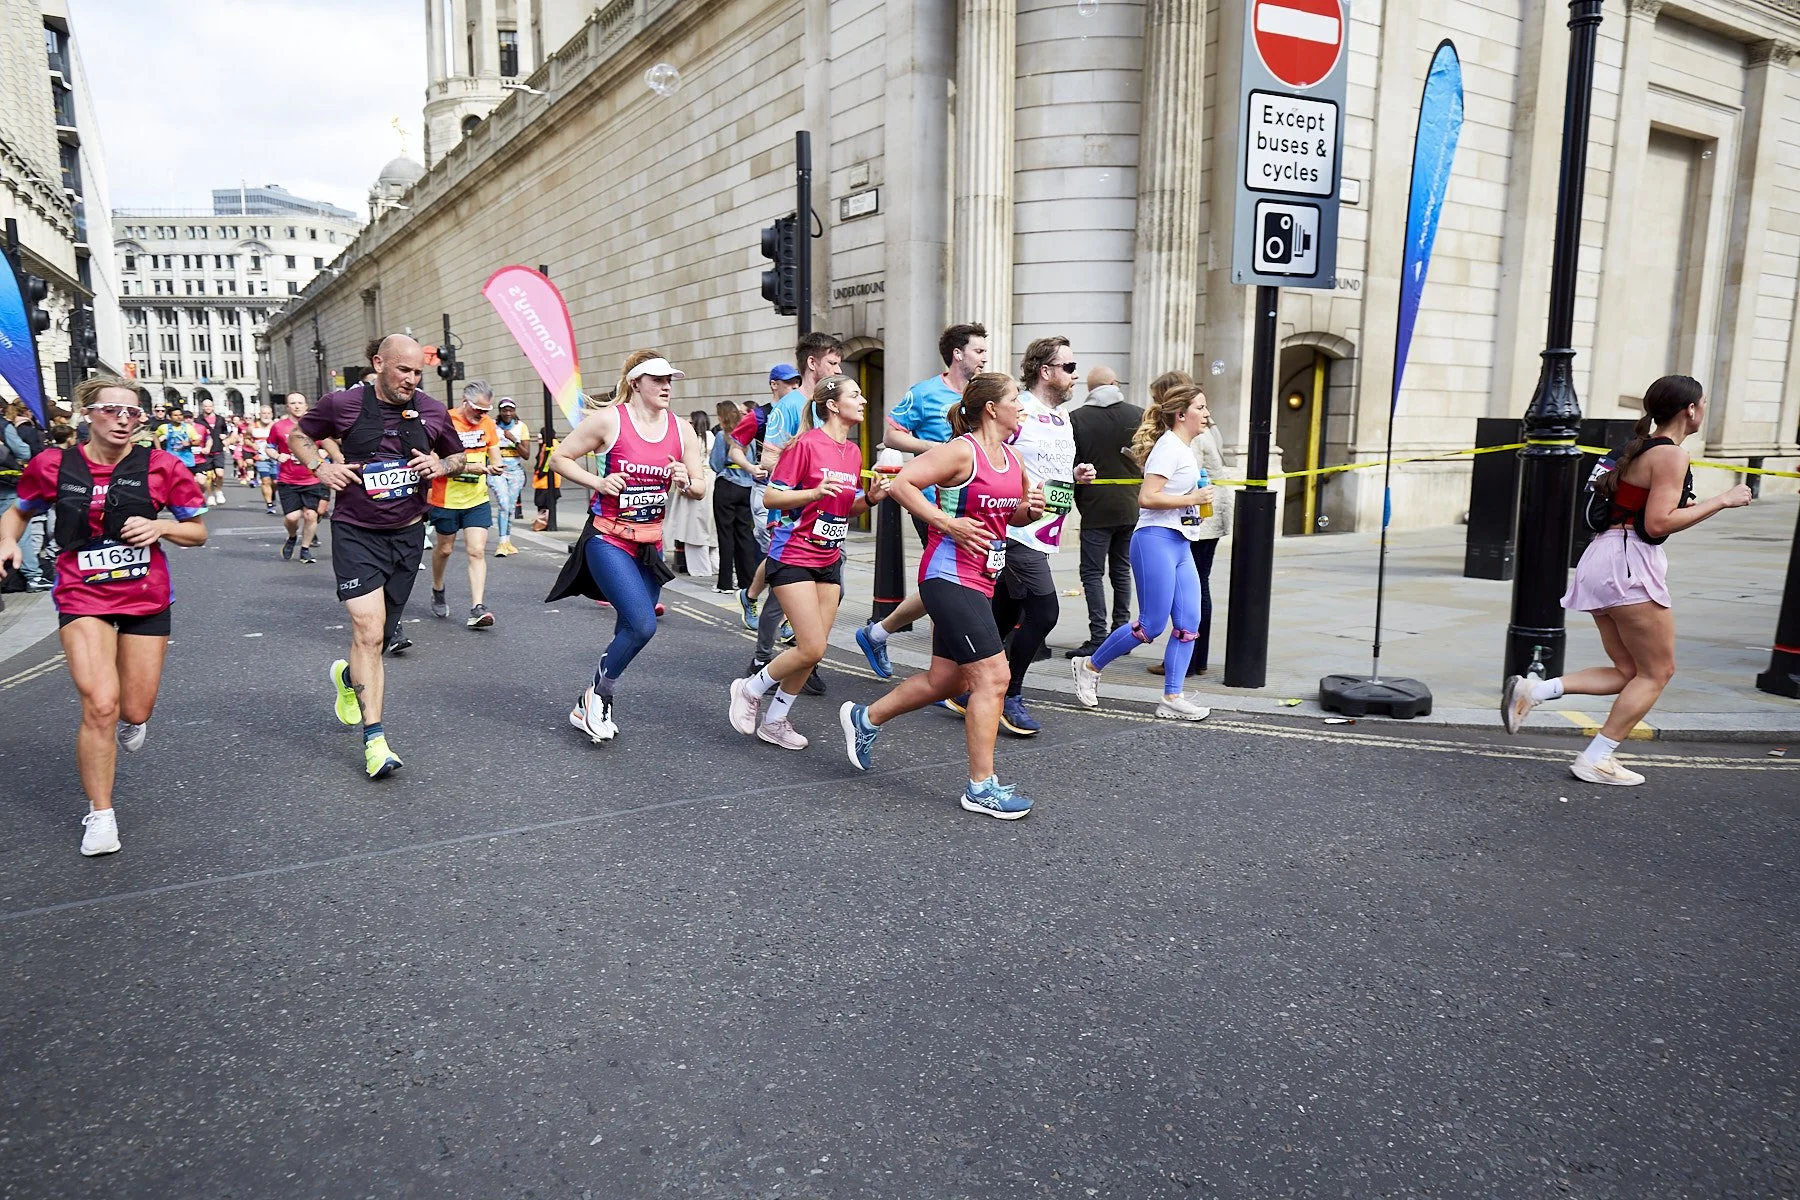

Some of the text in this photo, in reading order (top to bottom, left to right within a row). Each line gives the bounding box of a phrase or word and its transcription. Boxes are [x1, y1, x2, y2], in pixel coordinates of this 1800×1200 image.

[1263, 104, 1325, 133] Except
[1257, 130, 1327, 158] buses &
[1262, 161, 1318, 183] cycles
[369, 470, 418, 488] 10278
[624, 494, 665, 507] 10572
[84, 547, 146, 567] 11637
